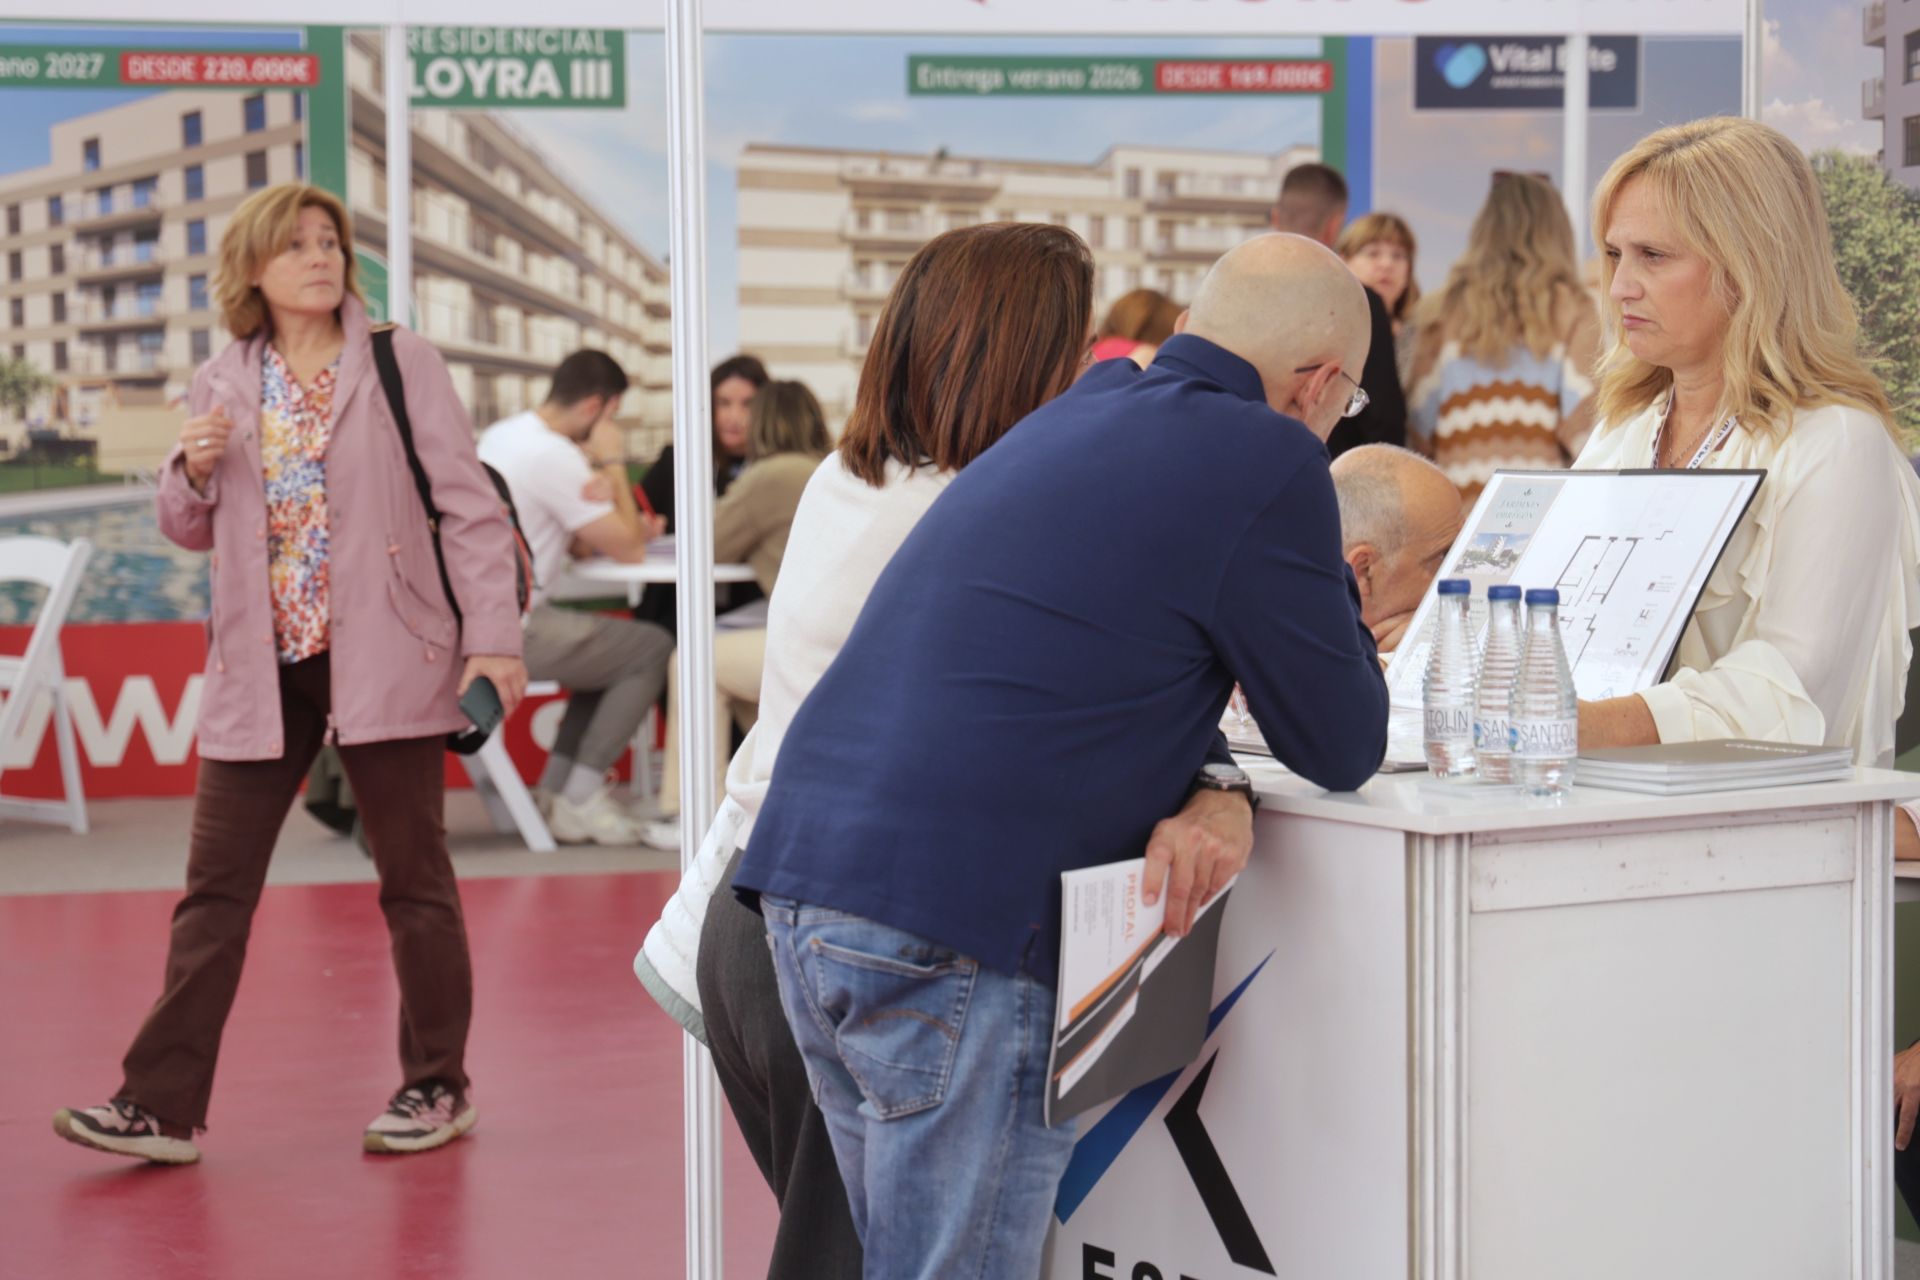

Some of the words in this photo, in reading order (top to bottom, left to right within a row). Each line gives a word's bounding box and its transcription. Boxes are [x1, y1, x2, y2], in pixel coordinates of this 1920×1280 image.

[407, 28, 610, 54] RESIDENCIAL
[44, 53, 104, 79] 2027
[128, 56, 198, 80] DESDE
[1489, 44, 1552, 72] Vital
[407, 57, 563, 99] LOYRA
[916, 62, 1004, 94] Entrega
[1007, 67, 1085, 90] verano
[1088, 63, 1143, 90] 2026
[1162, 65, 1223, 88] DESDE
[1124, 873, 1136, 944] PROFAL
